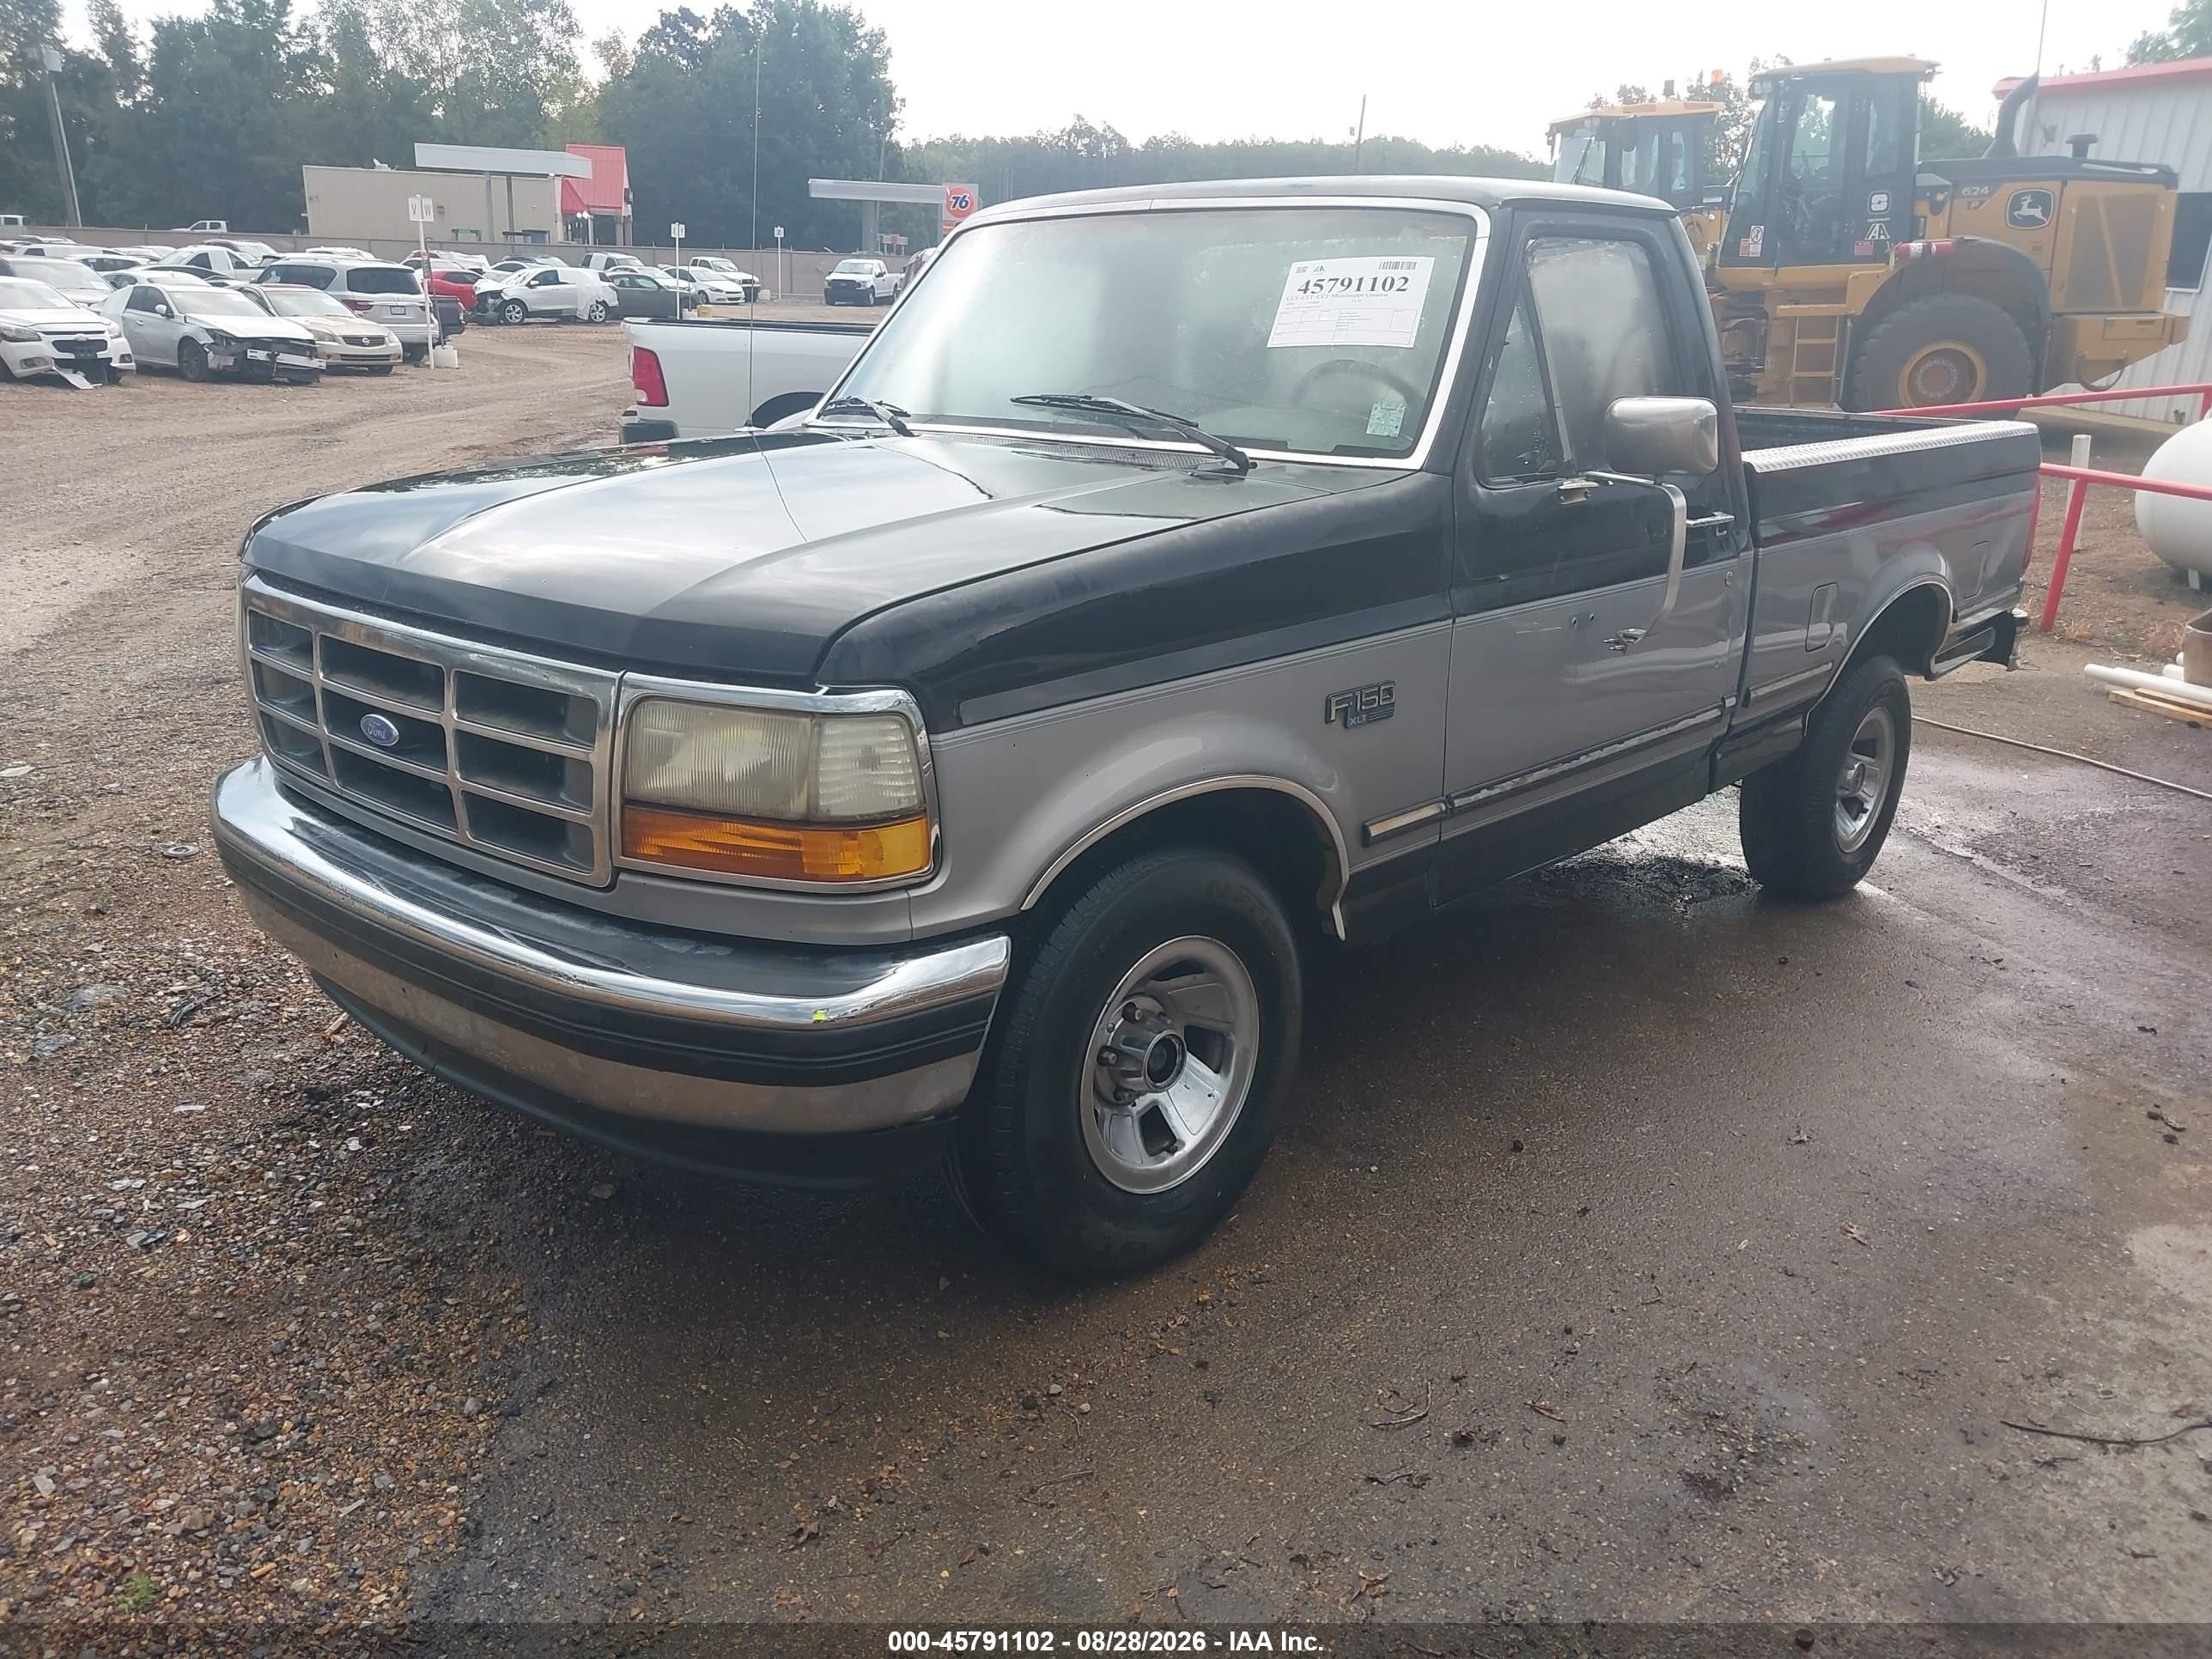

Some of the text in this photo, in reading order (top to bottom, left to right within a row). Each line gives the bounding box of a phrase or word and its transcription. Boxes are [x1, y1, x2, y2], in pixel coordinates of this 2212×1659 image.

[1961, 185, 1990, 197] 624
[949, 193, 970, 211] 76
[411, 203, 432, 216] V W
[1297, 275, 1410, 295] 45791102
[1349, 714, 1369, 726] XLT
